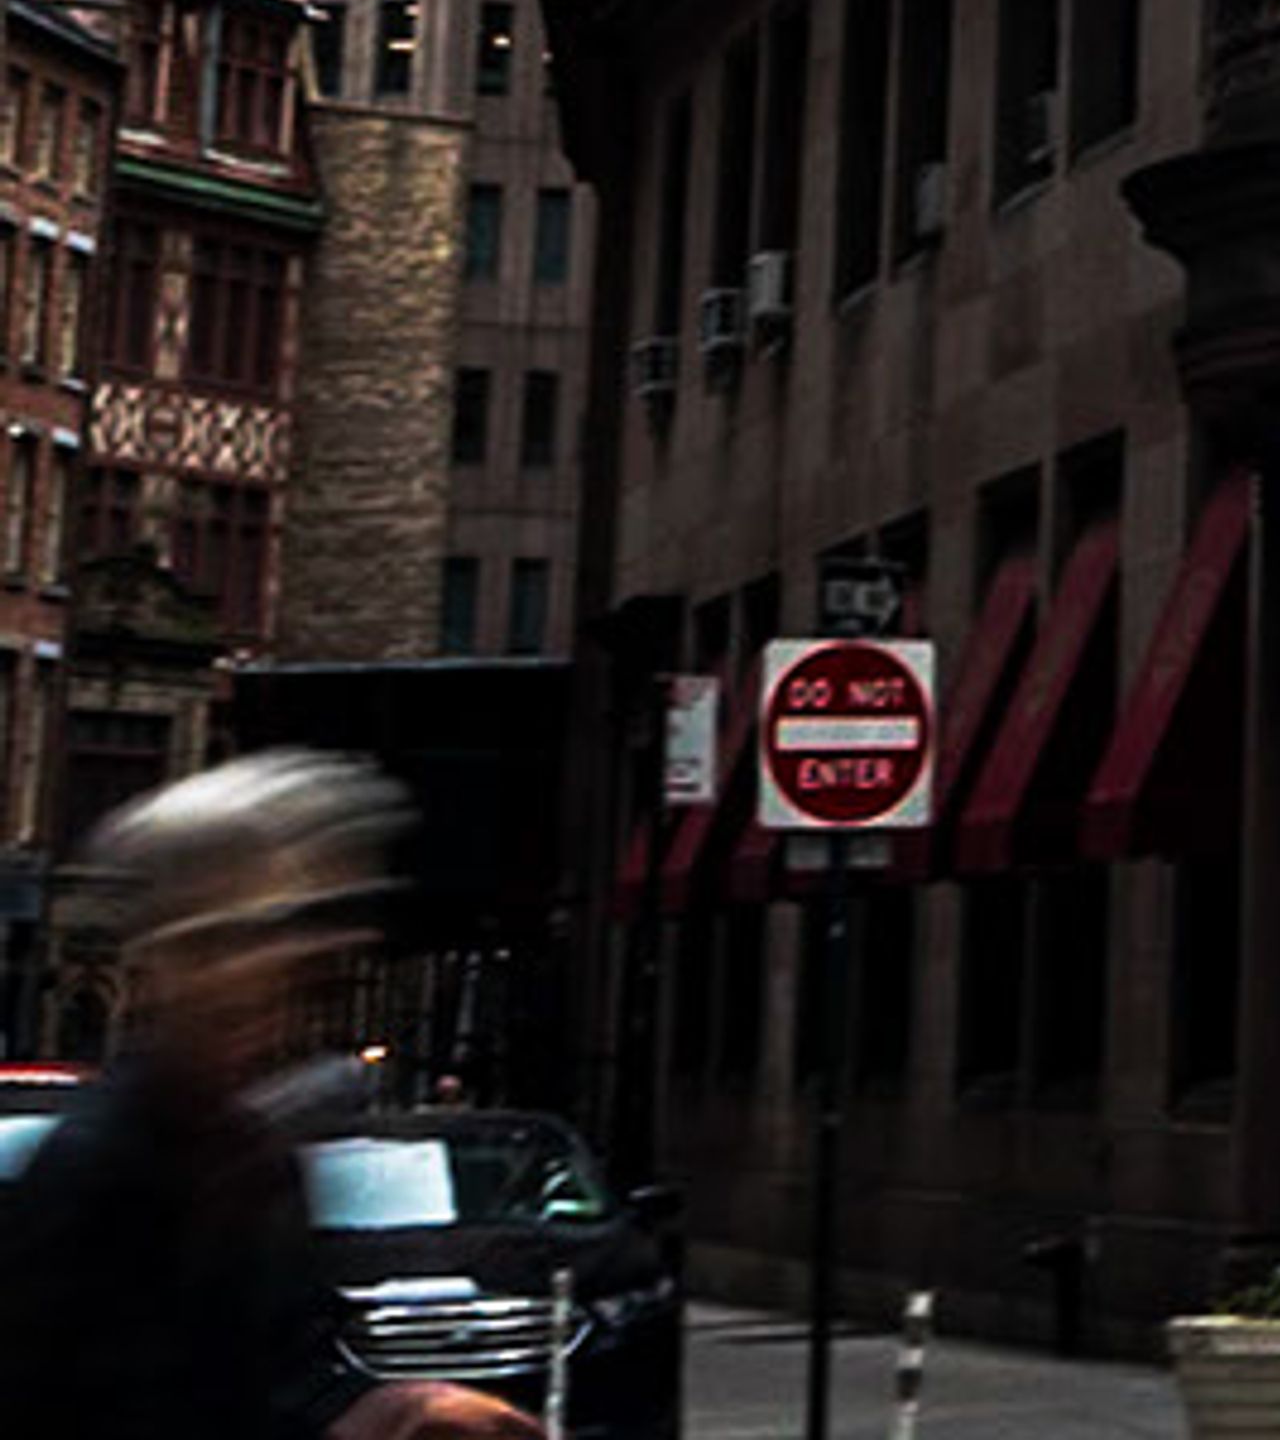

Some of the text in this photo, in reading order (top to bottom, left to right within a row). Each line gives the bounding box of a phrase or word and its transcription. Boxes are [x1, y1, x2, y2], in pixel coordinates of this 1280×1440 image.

[787, 676, 905, 709] DO NOT
[797, 756, 894, 790] ENTER
